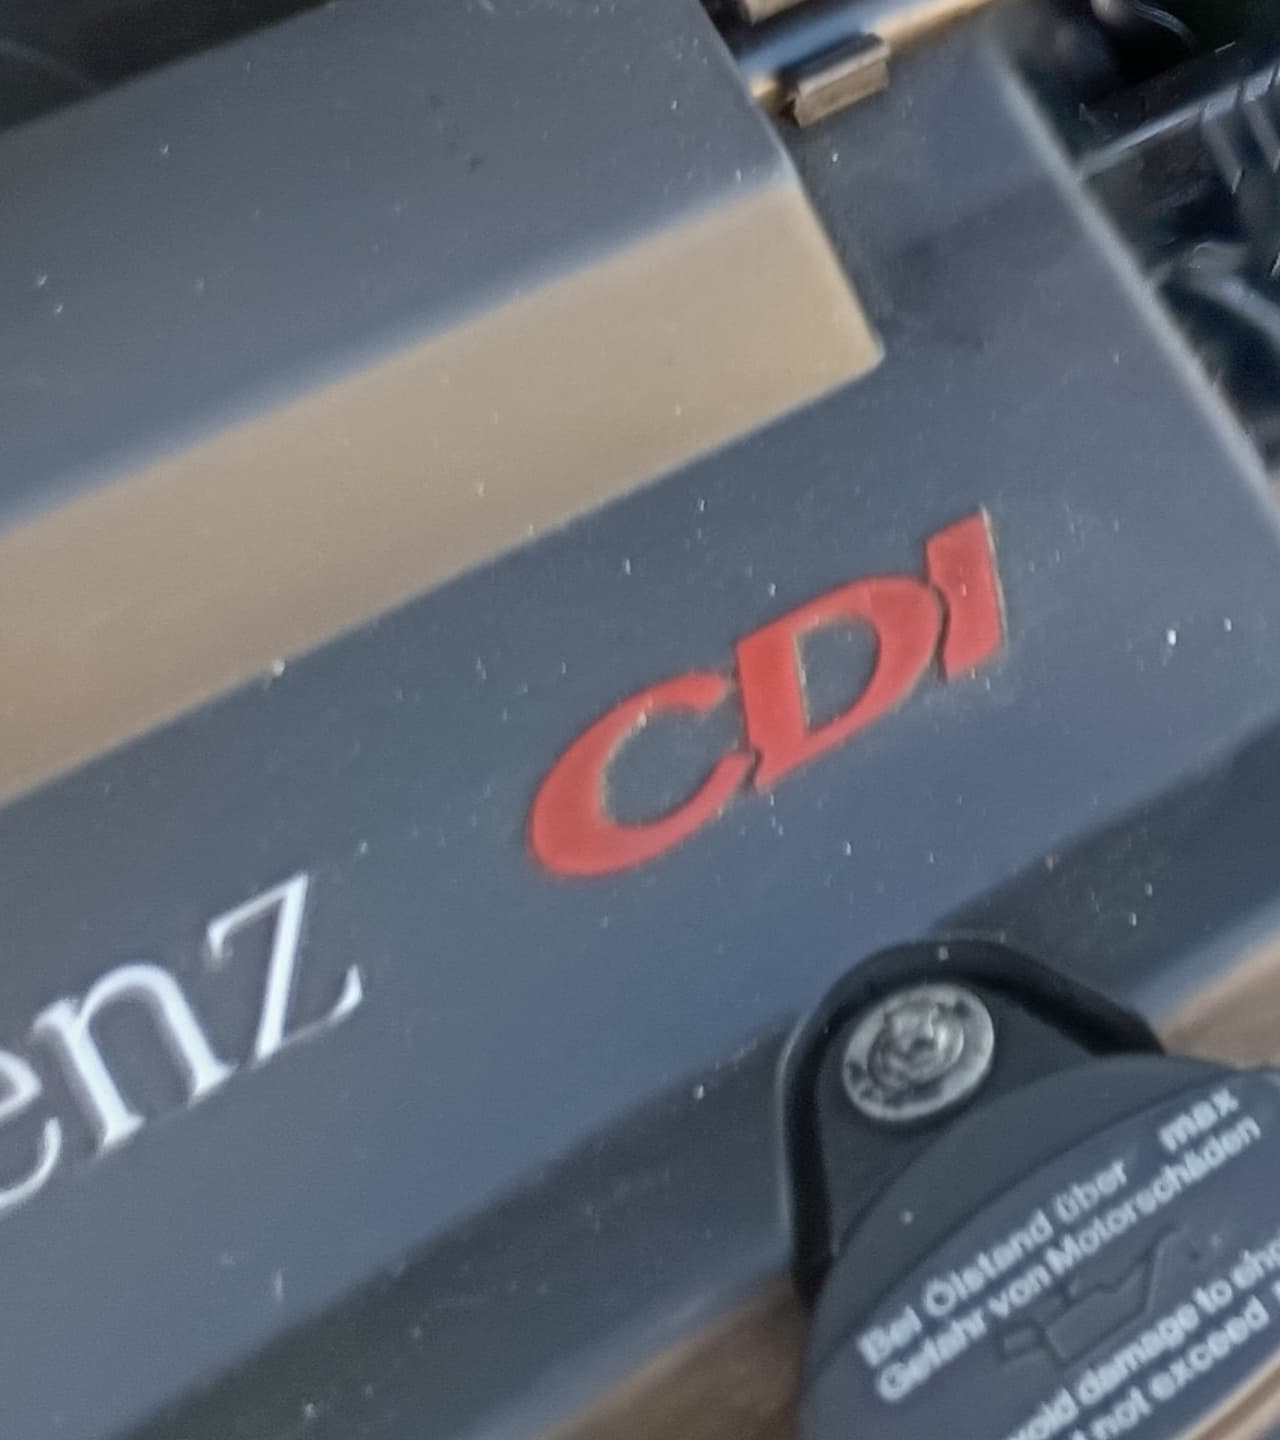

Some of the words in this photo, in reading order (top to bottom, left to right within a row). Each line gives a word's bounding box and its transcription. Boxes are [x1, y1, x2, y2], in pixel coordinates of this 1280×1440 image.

[526, 505, 1006, 879] CDI
[1158, 1086, 1241, 1154] max
[876, 1307, 988, 1403] Gefahr
[986, 1263, 1052, 1320] von
[1077, 1303, 1199, 1407] damage
[1195, 1278, 1233, 1316] to
[1148, 1295, 1270, 1401] exceed
